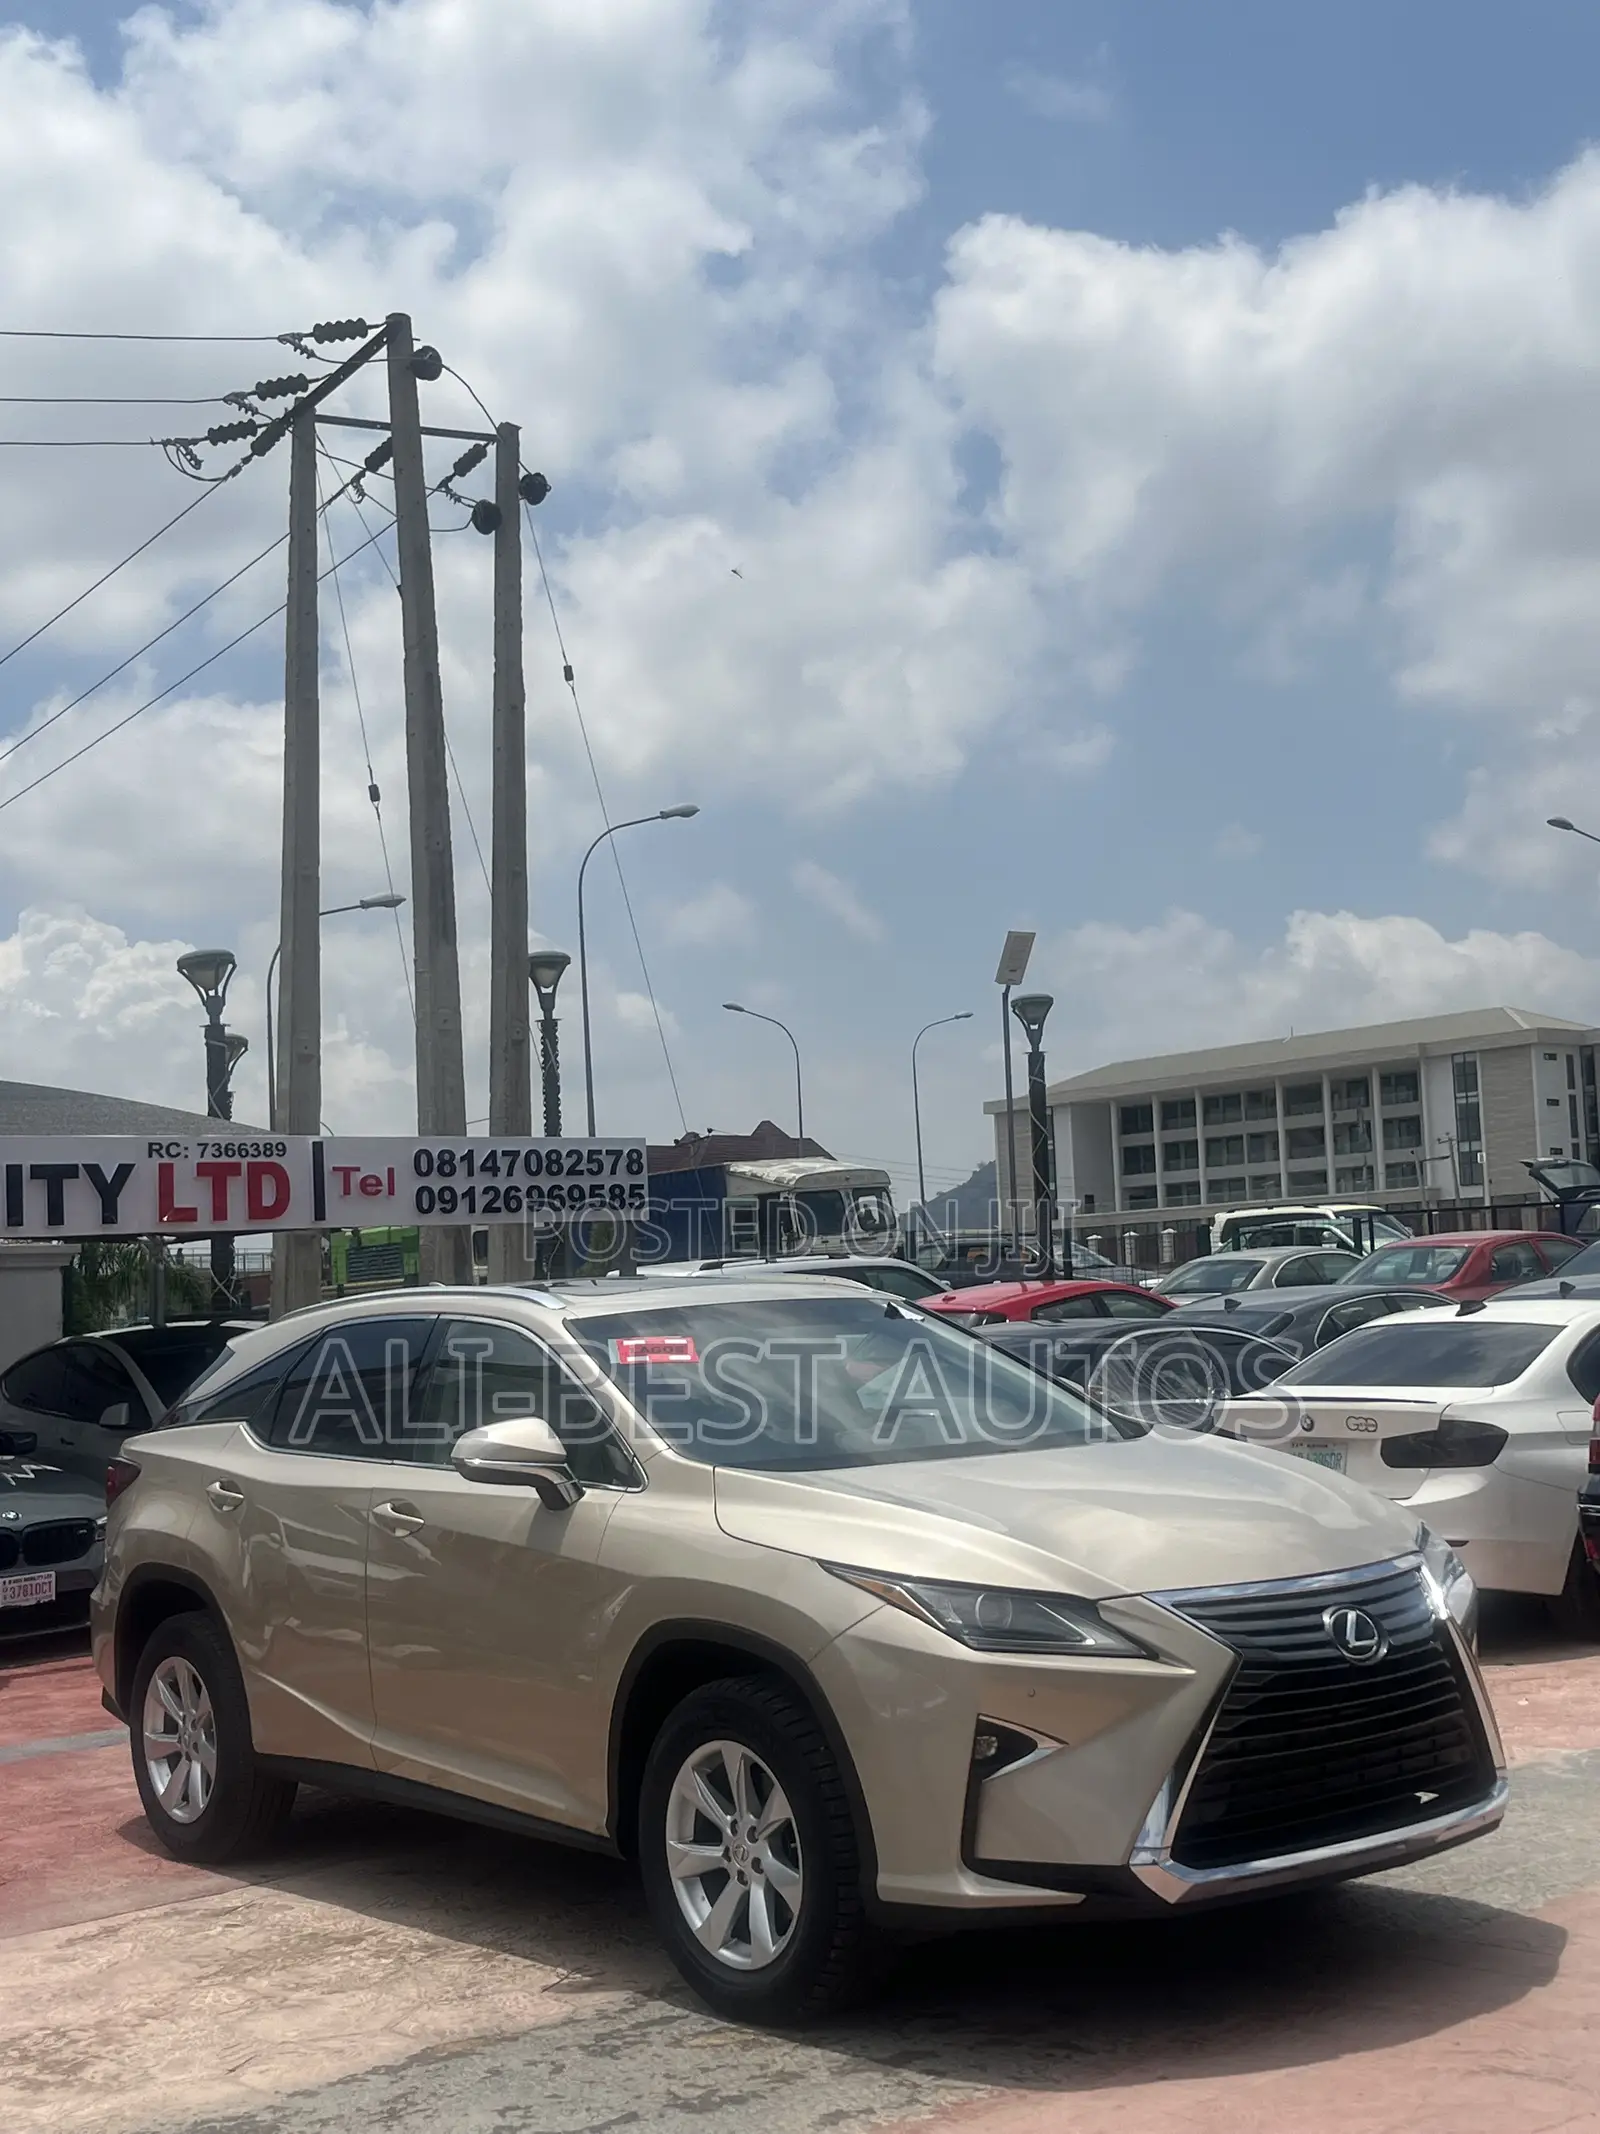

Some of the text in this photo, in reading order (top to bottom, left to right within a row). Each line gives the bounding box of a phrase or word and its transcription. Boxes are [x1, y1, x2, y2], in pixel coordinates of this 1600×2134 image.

[147, 1141, 288, 1159] RC: 7366389
[413, 1148, 645, 1178] 08147082578
[157, 1160, 291, 1223] LTD
[332, 1165, 396, 1197] Tel
[414, 1183, 646, 1215] 09126969585
